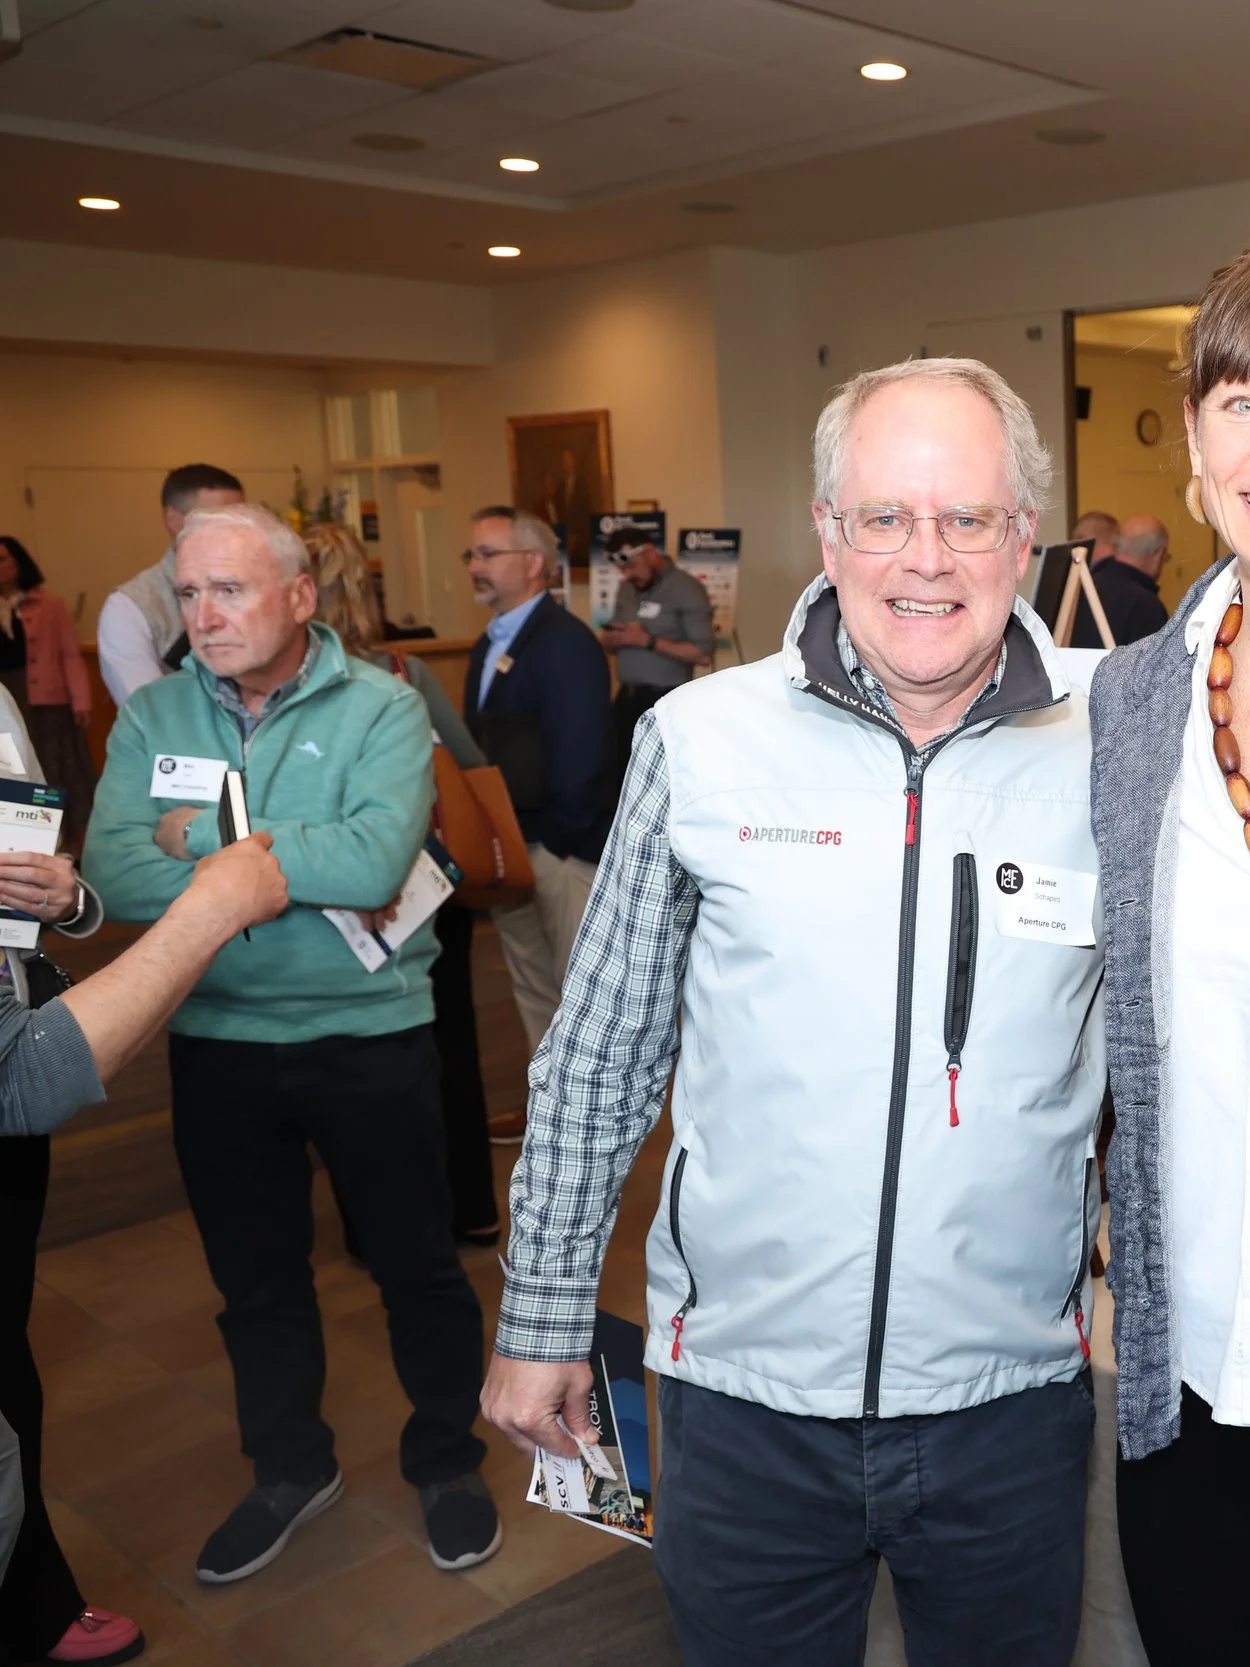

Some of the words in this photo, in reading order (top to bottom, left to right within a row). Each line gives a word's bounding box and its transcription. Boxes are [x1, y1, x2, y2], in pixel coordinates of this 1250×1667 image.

[16, 810, 38, 821] mti
[1036, 877, 1057, 887] Jamie
[1018, 916, 1050, 928] Aperture
[1051, 921, 1067, 931] CPG
[555, 1475, 569, 1509] SCV
